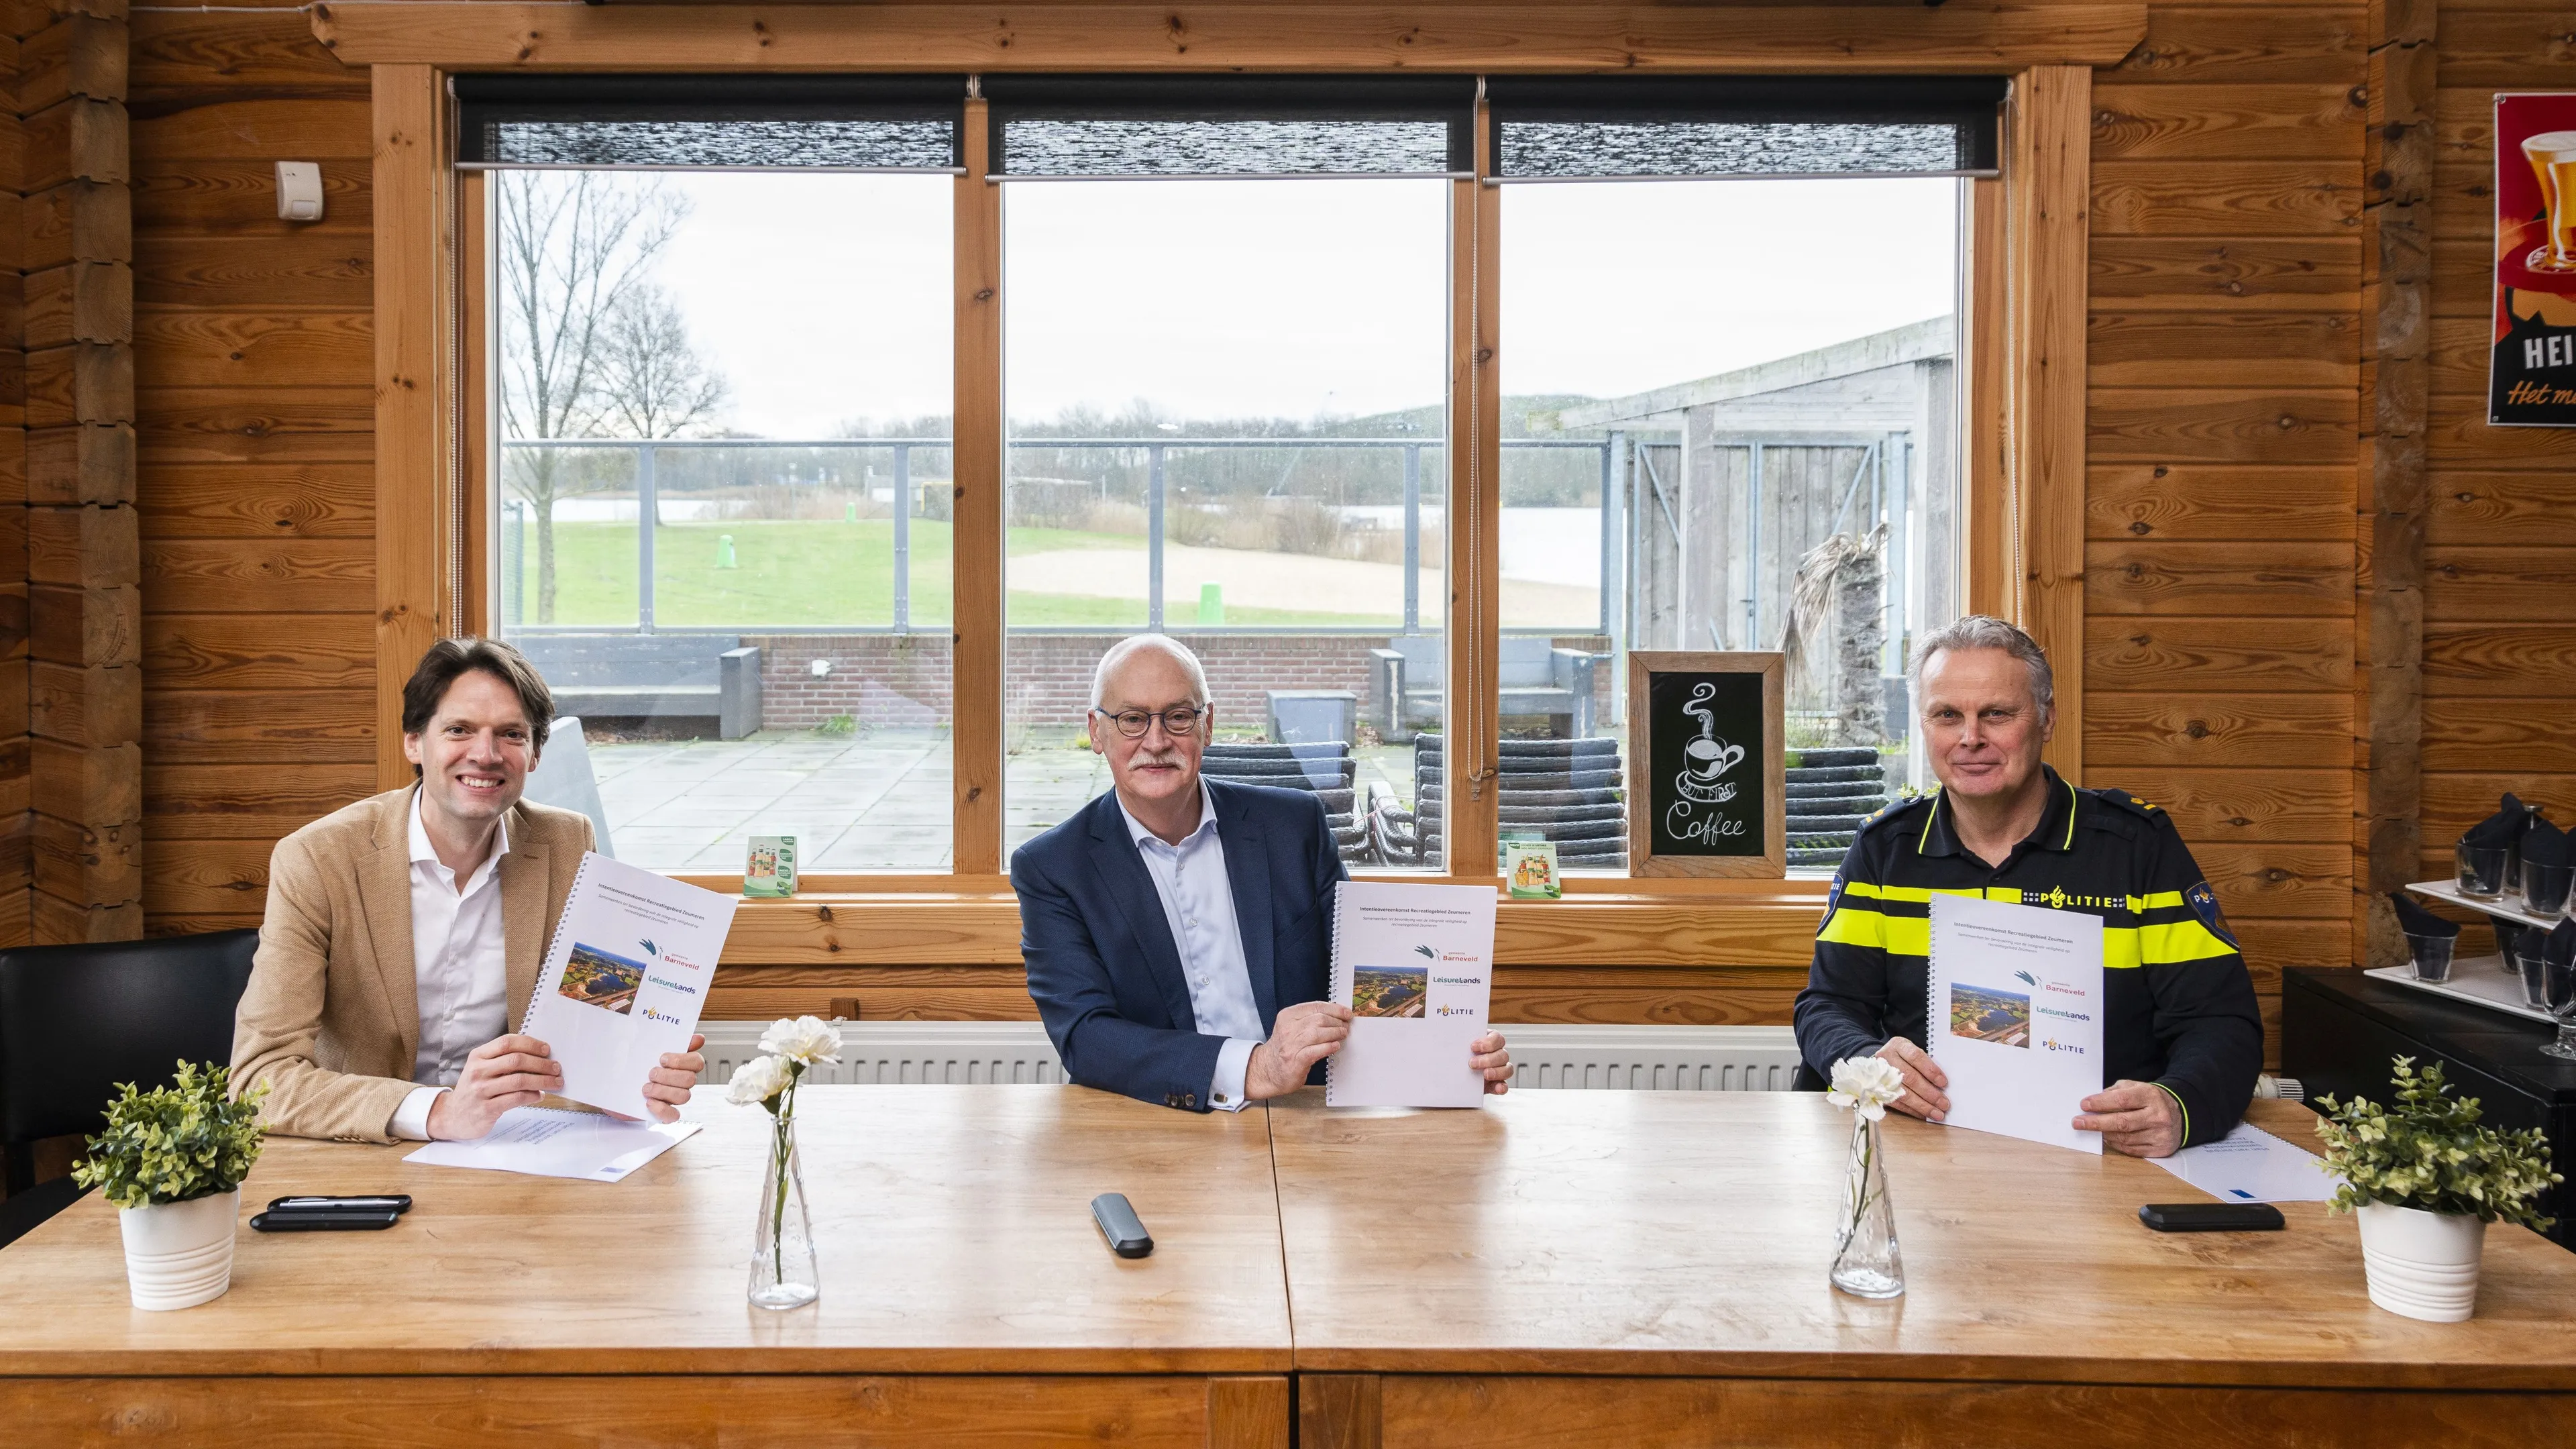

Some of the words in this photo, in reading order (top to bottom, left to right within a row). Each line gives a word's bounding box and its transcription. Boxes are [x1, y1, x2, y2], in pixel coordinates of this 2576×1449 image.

[2524, 334, 2574, 370] HEI
[2508, 380, 2552, 405] Het
[1680, 783, 1704, 800] BUT
[1708, 782, 1737, 800] FIRST
[1666, 799, 1746, 846] Coffee
[598, 883, 646, 903] Intentieovereenkomst
[647, 898, 682, 914] Recreatiegebied
[682, 910, 704, 920] Zeumeren
[2040, 890, 2112, 909] POLITIE
[1953, 922, 2007, 934] Intentieovereenkomst
[2007, 930, 2047, 940] Recreatiegebied
[2047, 936, 2074, 944] Zeumeren
[664, 955, 700, 971] Barneveld
[648, 975, 696, 994] LeisureLands
[1433, 976, 1481, 984] LeisureLands
[2045, 984, 2085, 997] Barneveld
[642, 1008, 681, 1025] POLITIE
[1437, 1006, 1474, 1016] POLITIE
[2036, 1006, 2090, 1022] LeisureLands
[2043, 1039, 2084, 1055] POLITIE
